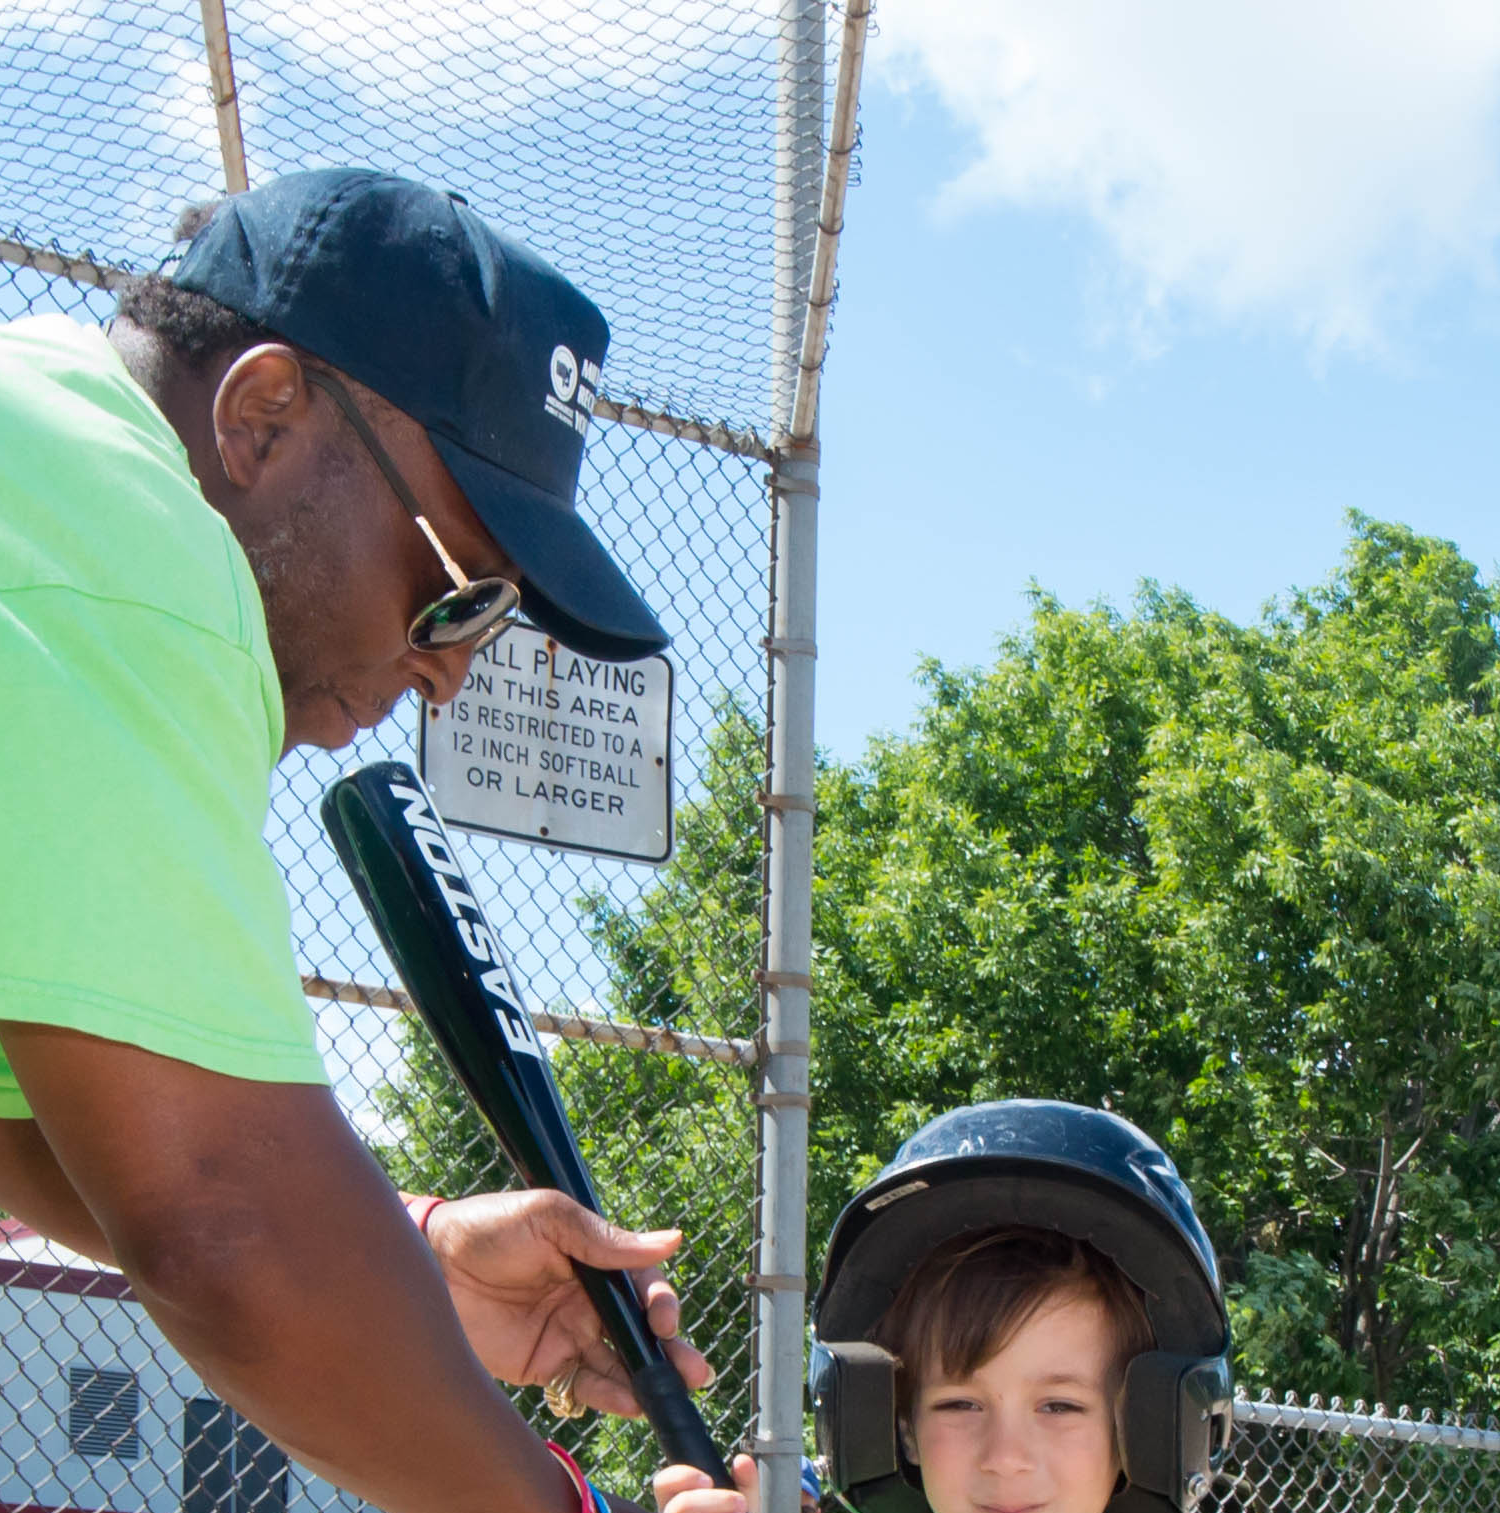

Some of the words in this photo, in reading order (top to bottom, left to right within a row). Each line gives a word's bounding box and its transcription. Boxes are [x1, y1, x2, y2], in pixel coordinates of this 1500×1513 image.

[533, 648, 646, 697] PLAYING
[450, 700, 469, 722] IS
[477, 704, 595, 749] RESTRICTED
[602, 731, 625, 755] TO
[629, 738, 643, 759] A
[503, 679, 561, 710] THIS
[569, 696, 639, 727] AREA
[453, 730, 473, 754] 12
[482, 737, 529, 766] INCH
[539, 750, 641, 789] SOFTBALL
[466, 766, 503, 792] OR
[515, 775, 624, 816] LARGER
[388, 783, 544, 1061] EASTON
